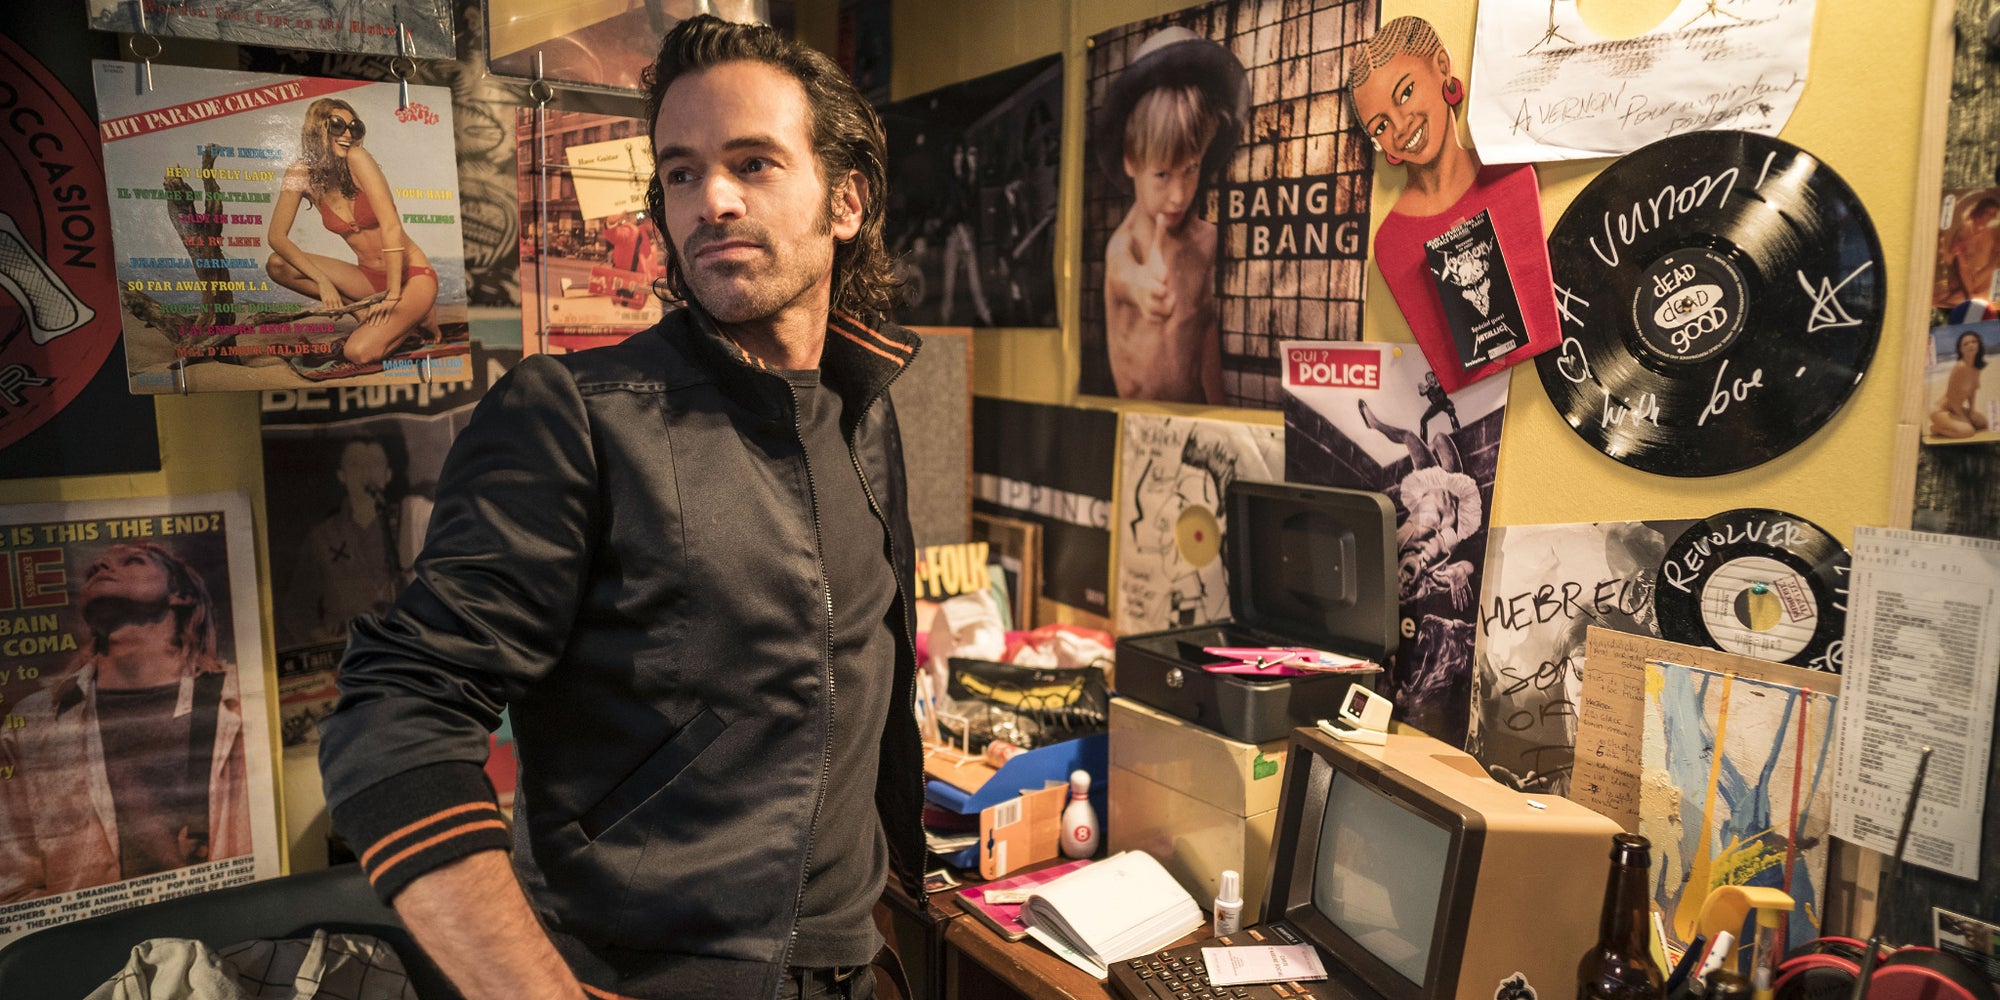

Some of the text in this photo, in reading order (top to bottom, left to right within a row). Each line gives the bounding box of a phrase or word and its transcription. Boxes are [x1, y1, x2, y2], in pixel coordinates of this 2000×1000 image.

[319, 18, 343, 31] the
[351, 20, 412, 37] Highwy
[101, 83, 304, 139] HIT PARADE CHANTE
[1509, 97, 1532, 136] A
[1538, 80, 1627, 126] VERNON
[0, 80, 97, 269] OCCASION
[165, 167, 275, 182] HEY LOVELY LADY
[117, 188, 131, 200] IL
[133, 188, 183, 201] VOYAGE
[205, 191, 271, 204] SOLITAIRE
[395, 188, 453, 200] YOUR HAIR
[1229, 182, 1329, 220] BANG
[178, 212, 211, 225] LADY
[231, 214, 263, 225] BLUE
[402, 213, 455, 225] FEELINGS
[1253, 221, 1360, 256] BANG
[195, 257, 259, 270] CARNAVAL
[128, 281, 272, 292] SO FAR AWAY FROM L.A.
[160, 302, 194, 314] ROCK
[214, 303, 244, 314] ROLL
[248, 302, 302, 314] DOLLARS
[207, 324, 255, 336] ENCORE
[176, 346, 205, 358] MAL
[266, 345, 294, 355] MAL
[294, 344, 311, 355] DE
[312, 344, 332, 354] TOI
[1291, 350, 1329, 363] QUI ?
[382, 359, 414, 370] MARIO
[1299, 362, 1378, 387] POLICE
[10, 513, 220, 546] IS THIS THE END?
[1663, 520, 1810, 594] REVOLVER
[22, 555, 37, 599] EXPRESS
[3, 633, 78, 657] COMA
[16, 664, 39, 680] to
[61, 900, 91, 913] THESE
[94, 892, 131, 907] ANIMAL
[132, 887, 153, 898] MEN
[167, 880, 185, 891] POP
[186, 876, 207, 887] WILL
[210, 871, 225, 881] EAT
[227, 865, 255, 877] ITSELF
[76, 882, 128, 900] SMASHING
[129, 871, 178, 891] PUMPKINS
[190, 864, 212, 876] DAVE
[214, 861, 230, 871] LEE
[26, 913, 78, 931] THERAPY?
[91, 898, 146, 917] MORRISSEY
[158, 885, 207, 901] PRESSURE
